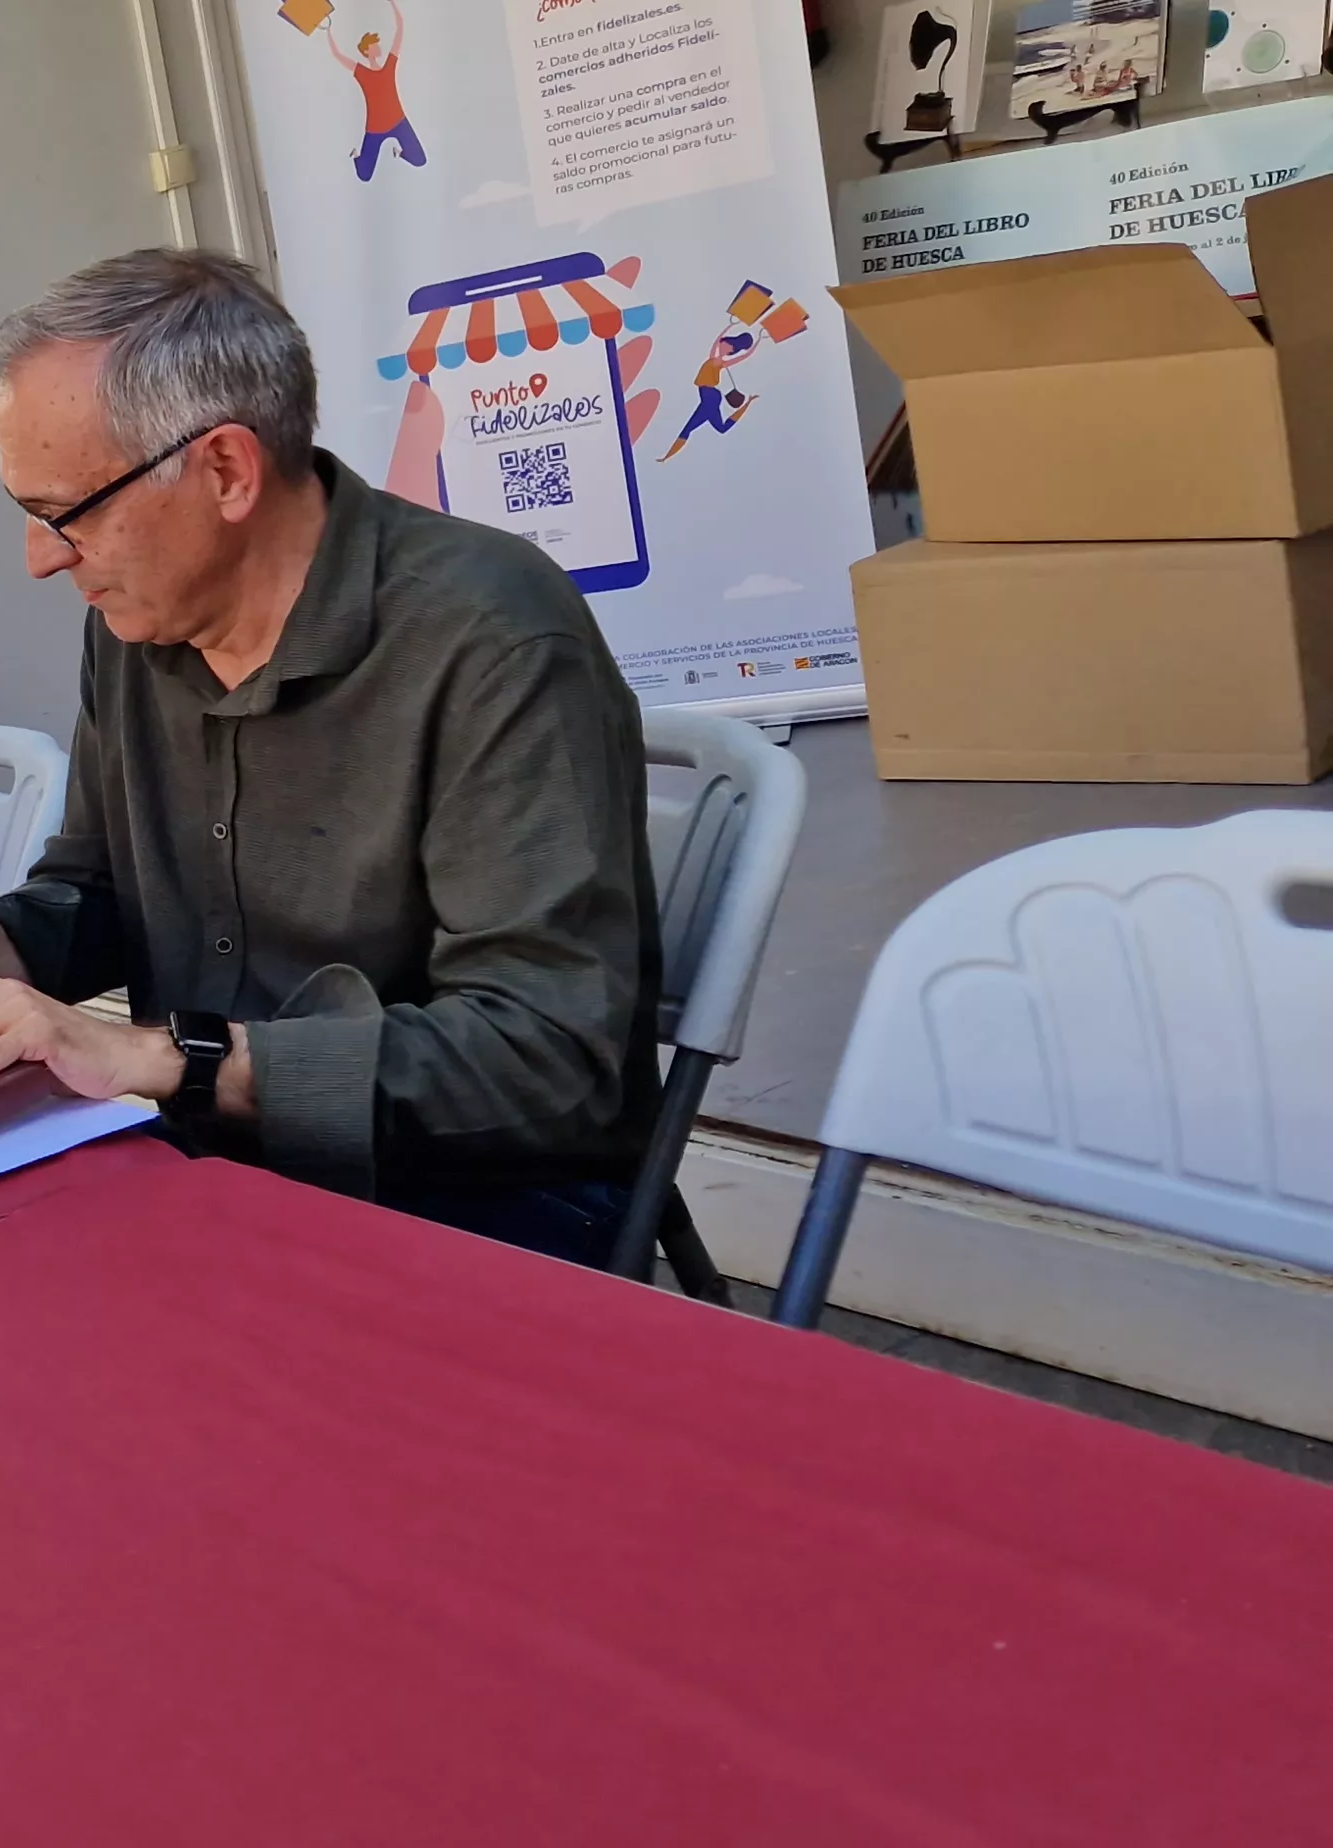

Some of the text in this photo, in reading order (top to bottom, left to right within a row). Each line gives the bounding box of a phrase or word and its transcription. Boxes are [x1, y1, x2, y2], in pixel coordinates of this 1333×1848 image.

[536, 17, 713, 71] 2. Date de alta y Localiza los
[577, 26, 593, 37] en
[539, 58, 605, 84] comercios
[608, 41, 674, 66] adheridos
[541, 82, 576, 98] zales.
[544, 66, 722, 120] 3. Realizar una compra en el
[546, 79, 731, 133] comercio y pedir al vendedor
[548, 95, 730, 147] que quieres acumular saldo.
[551, 116, 734, 166] 4. El comercio te asignará un
[553, 132, 737, 181] saldo promocional para futu-
[555, 169, 634, 195] ras compras.
[1109, 162, 1189, 185] 40 Edición
[1109, 188, 1185, 215] FERIA
[1190, 177, 1245, 200] DEL
[862, 205, 925, 223] 40 Edición
[862, 213, 1029, 250] FERIA DEL LIBRO
[1109, 222, 1140, 240] DE
[1201, 240, 1212, 248] al
[1216, 237, 1223, 246] 2
[1227, 236, 1241, 244] de
[862, 246, 965, 274] DE HUESCA
[470, 380, 529, 412] Punto
[619, 661, 651, 669] ERCIO
[662, 653, 712, 665] SERVICIOS
[713, 651, 726, 659] DE
[729, 649, 742, 657] LA
[744, 643, 798, 655] PROVINCIA
[801, 640, 814, 648] DE
[817, 636, 858, 647] HUESCA
[700, 644, 713, 652] DE
[716, 641, 733, 650] LAS
[736, 632, 809, 647] ASOCIACIONES
